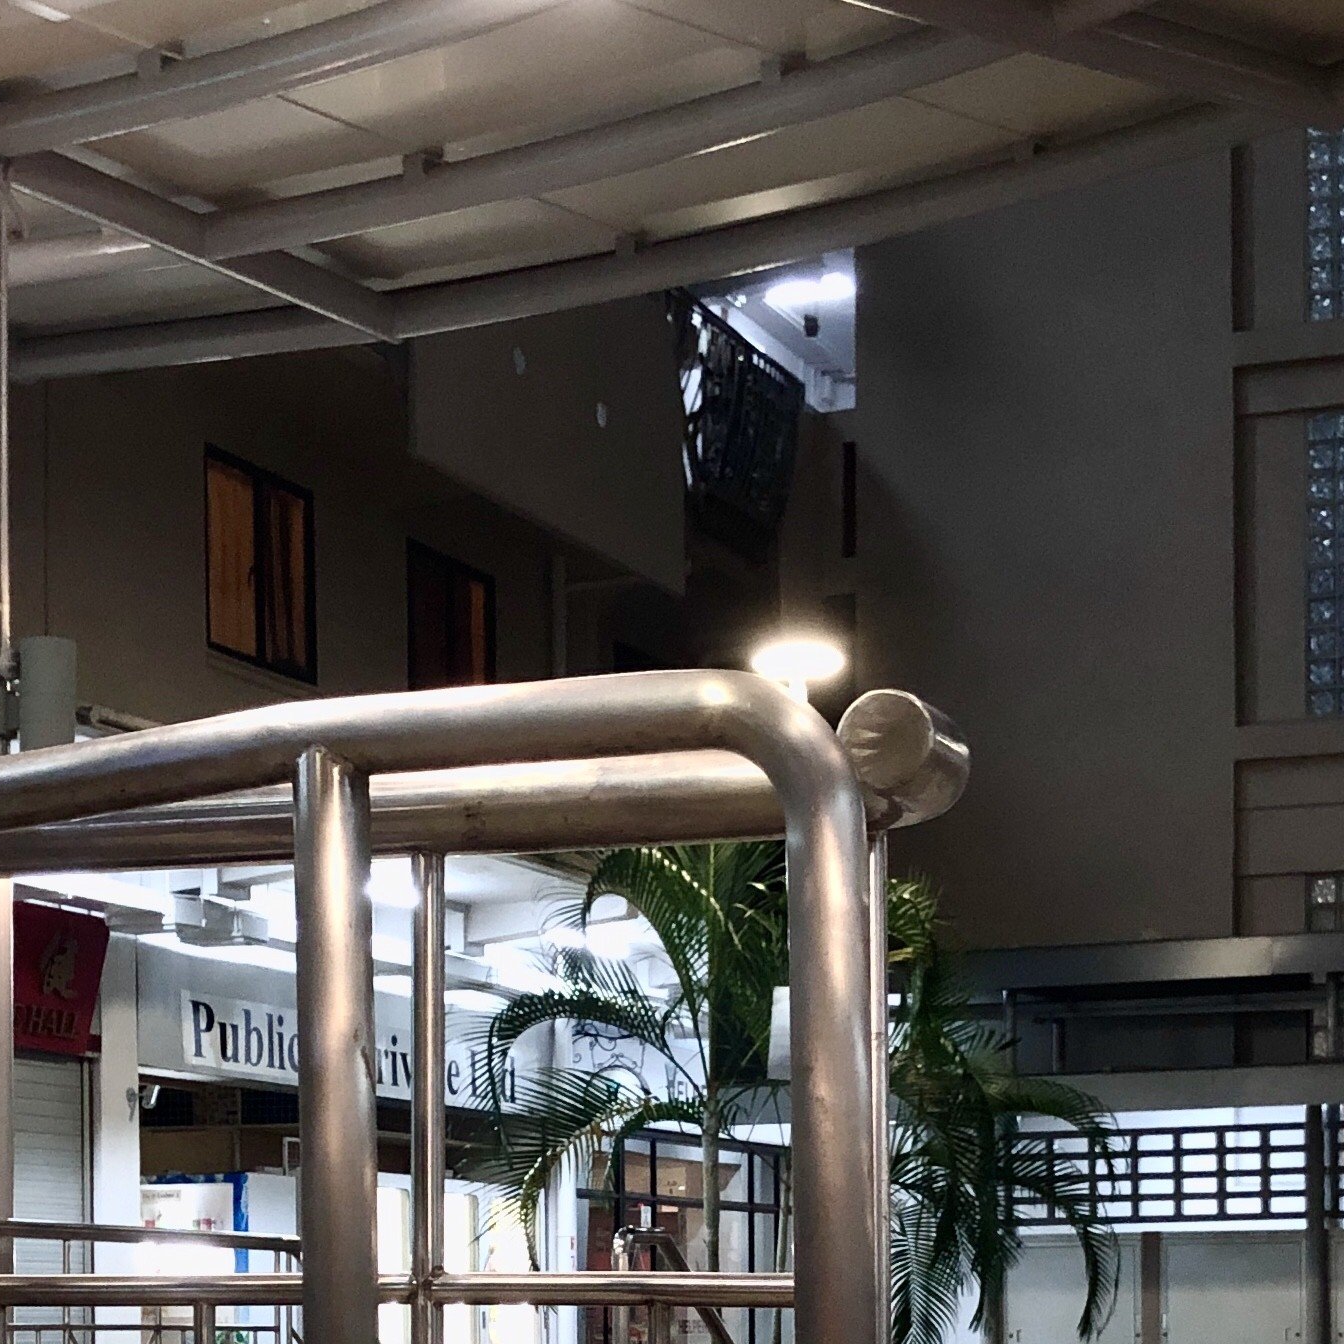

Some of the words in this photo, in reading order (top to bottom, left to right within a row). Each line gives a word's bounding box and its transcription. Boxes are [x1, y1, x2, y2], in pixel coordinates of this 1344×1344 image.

[189, 999, 299, 1073] Public
[375, 1033, 461, 1096] rive
[469, 1049, 516, 1104] Ld
